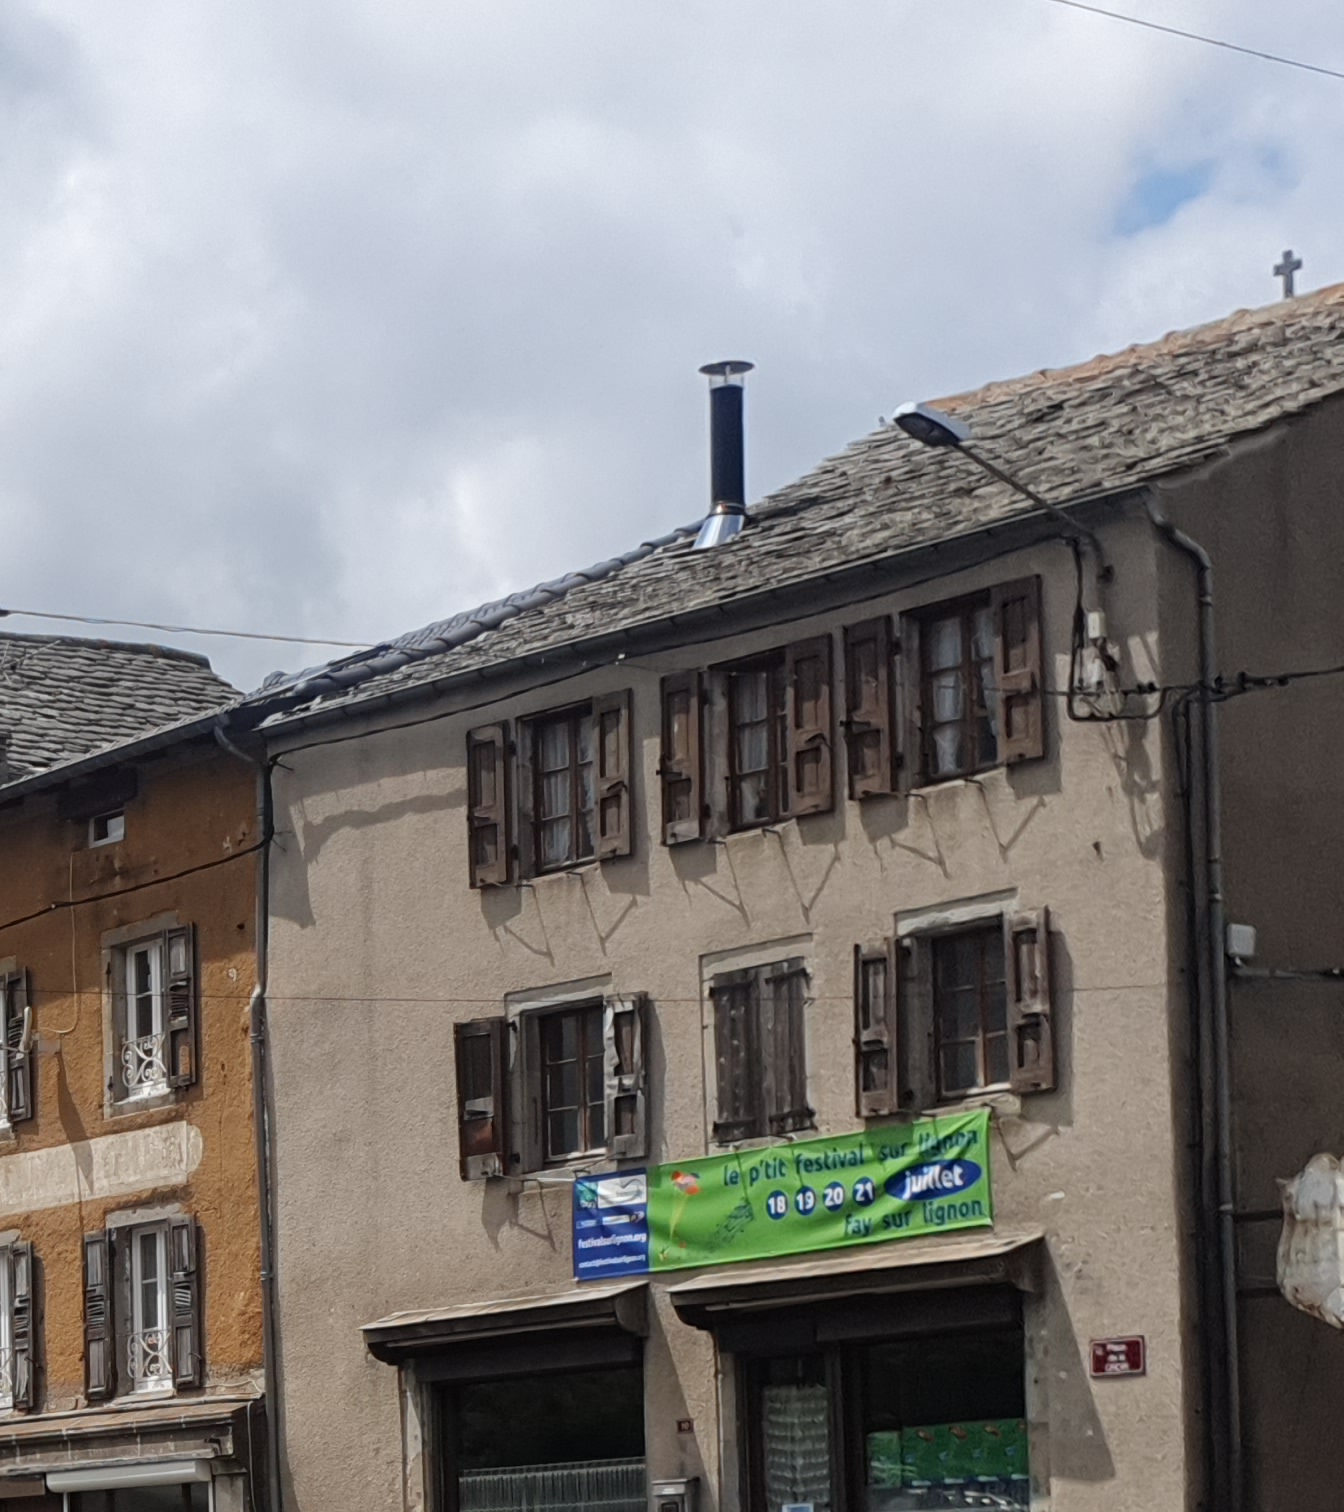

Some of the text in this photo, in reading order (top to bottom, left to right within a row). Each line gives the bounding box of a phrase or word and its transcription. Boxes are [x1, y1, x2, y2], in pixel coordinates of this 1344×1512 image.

[723, 1165, 739, 1186] le
[795, 1143, 864, 1175] festival
[879, 1142, 907, 1161] sur
[768, 1165, 964, 1215] 18 19 20 21 juillet
[845, 1200, 983, 1237] fay sur lignon
